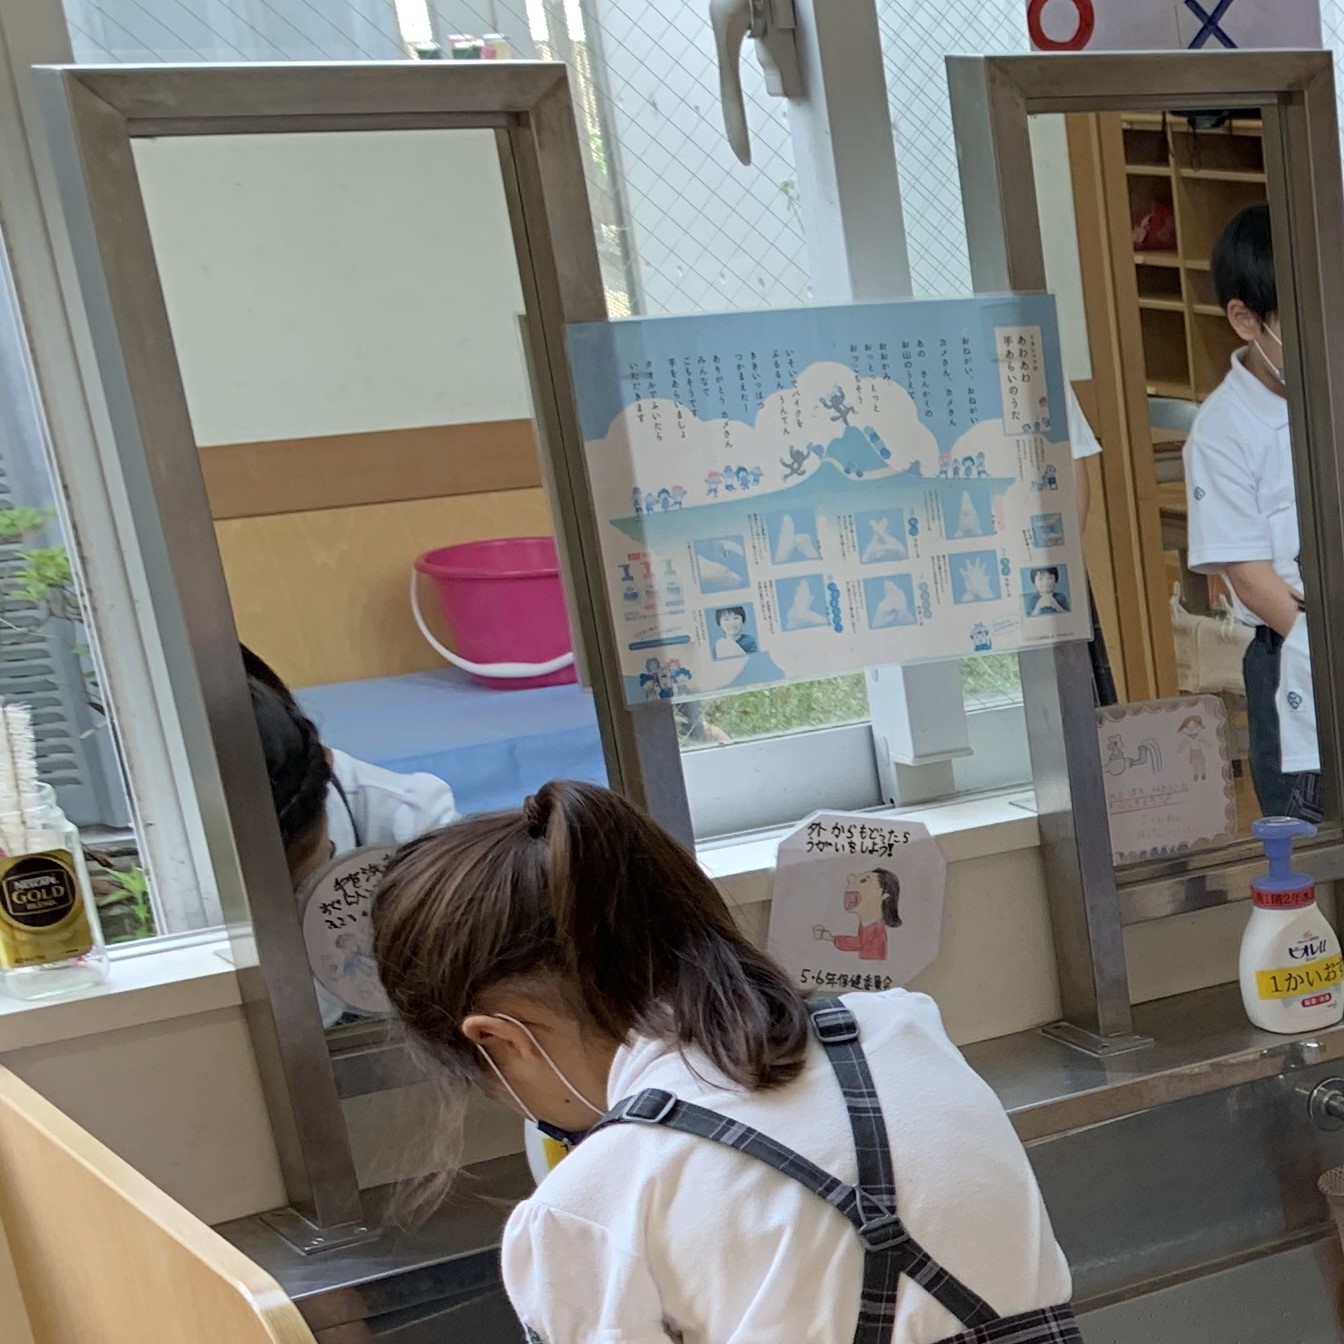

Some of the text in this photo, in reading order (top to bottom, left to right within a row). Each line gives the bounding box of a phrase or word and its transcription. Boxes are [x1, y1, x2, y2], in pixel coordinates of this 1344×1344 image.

[697, 355, 711, 397] みんなで
[712, 354, 726, 405] ありがとう
[1003, 335, 1021, 421] 手あらいのうた
[1017, 335, 1031, 383] あわあわ
[629, 363, 645, 423] いただきます
[12, 885, 65, 905] GOLD
